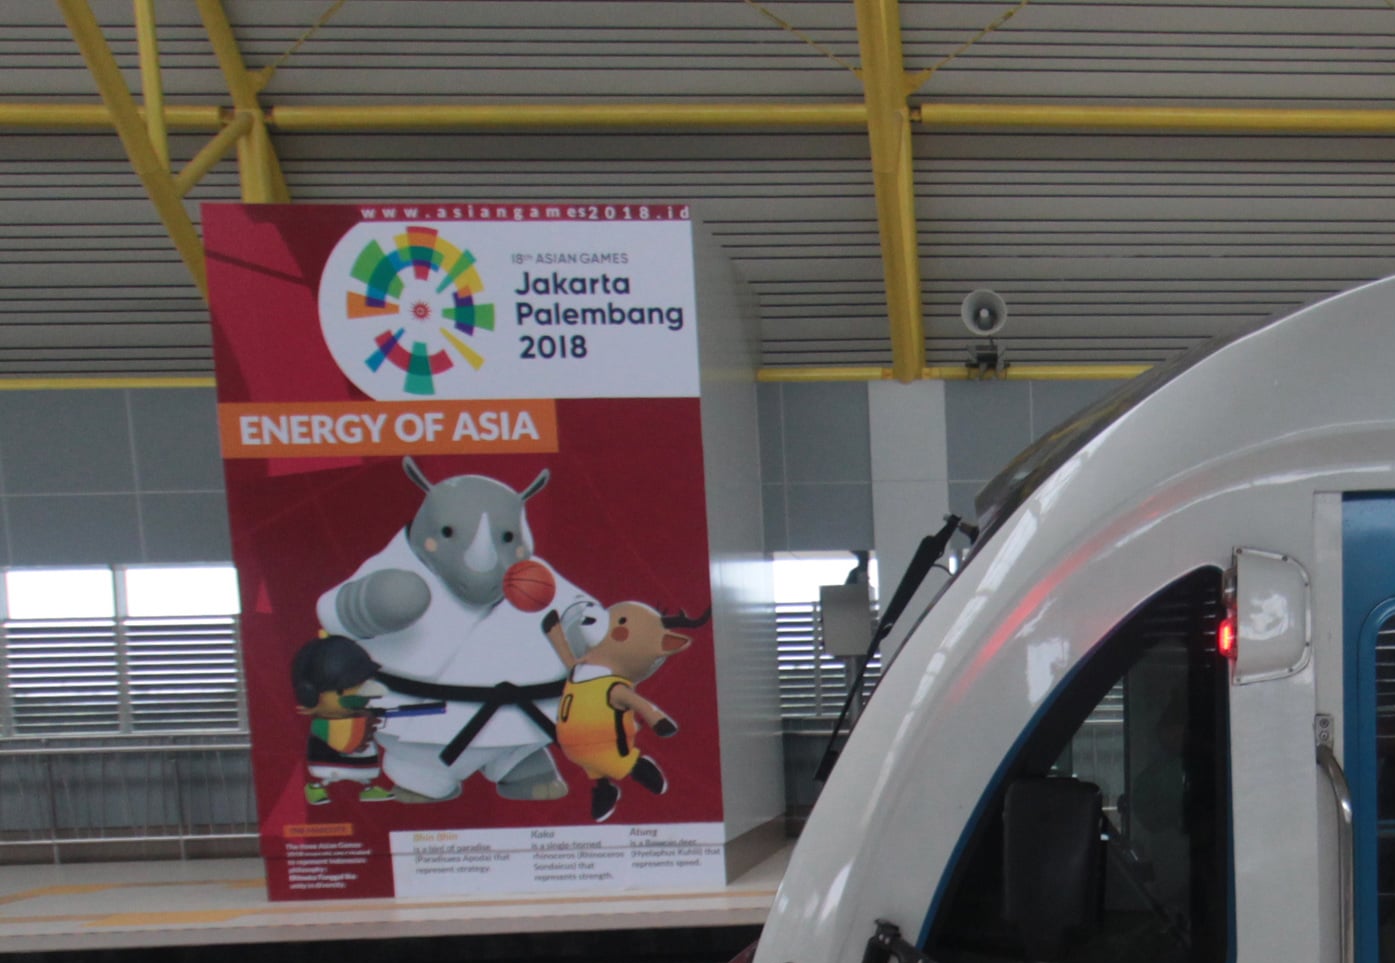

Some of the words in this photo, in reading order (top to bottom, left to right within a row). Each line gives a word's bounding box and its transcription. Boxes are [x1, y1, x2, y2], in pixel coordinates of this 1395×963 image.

[361, 205, 690, 221] www.asiangames2018.id
[535, 253, 577, 265] ASIAN
[579, 252, 629, 264] GAMES
[515, 271, 631, 296] Jakarta
[515, 301, 684, 331] Palembang
[519, 334, 588, 359] 2018
[239, 413, 388, 445] ENERGY
[394, 412, 444, 442] OF
[451, 411, 540, 441] ASIA
